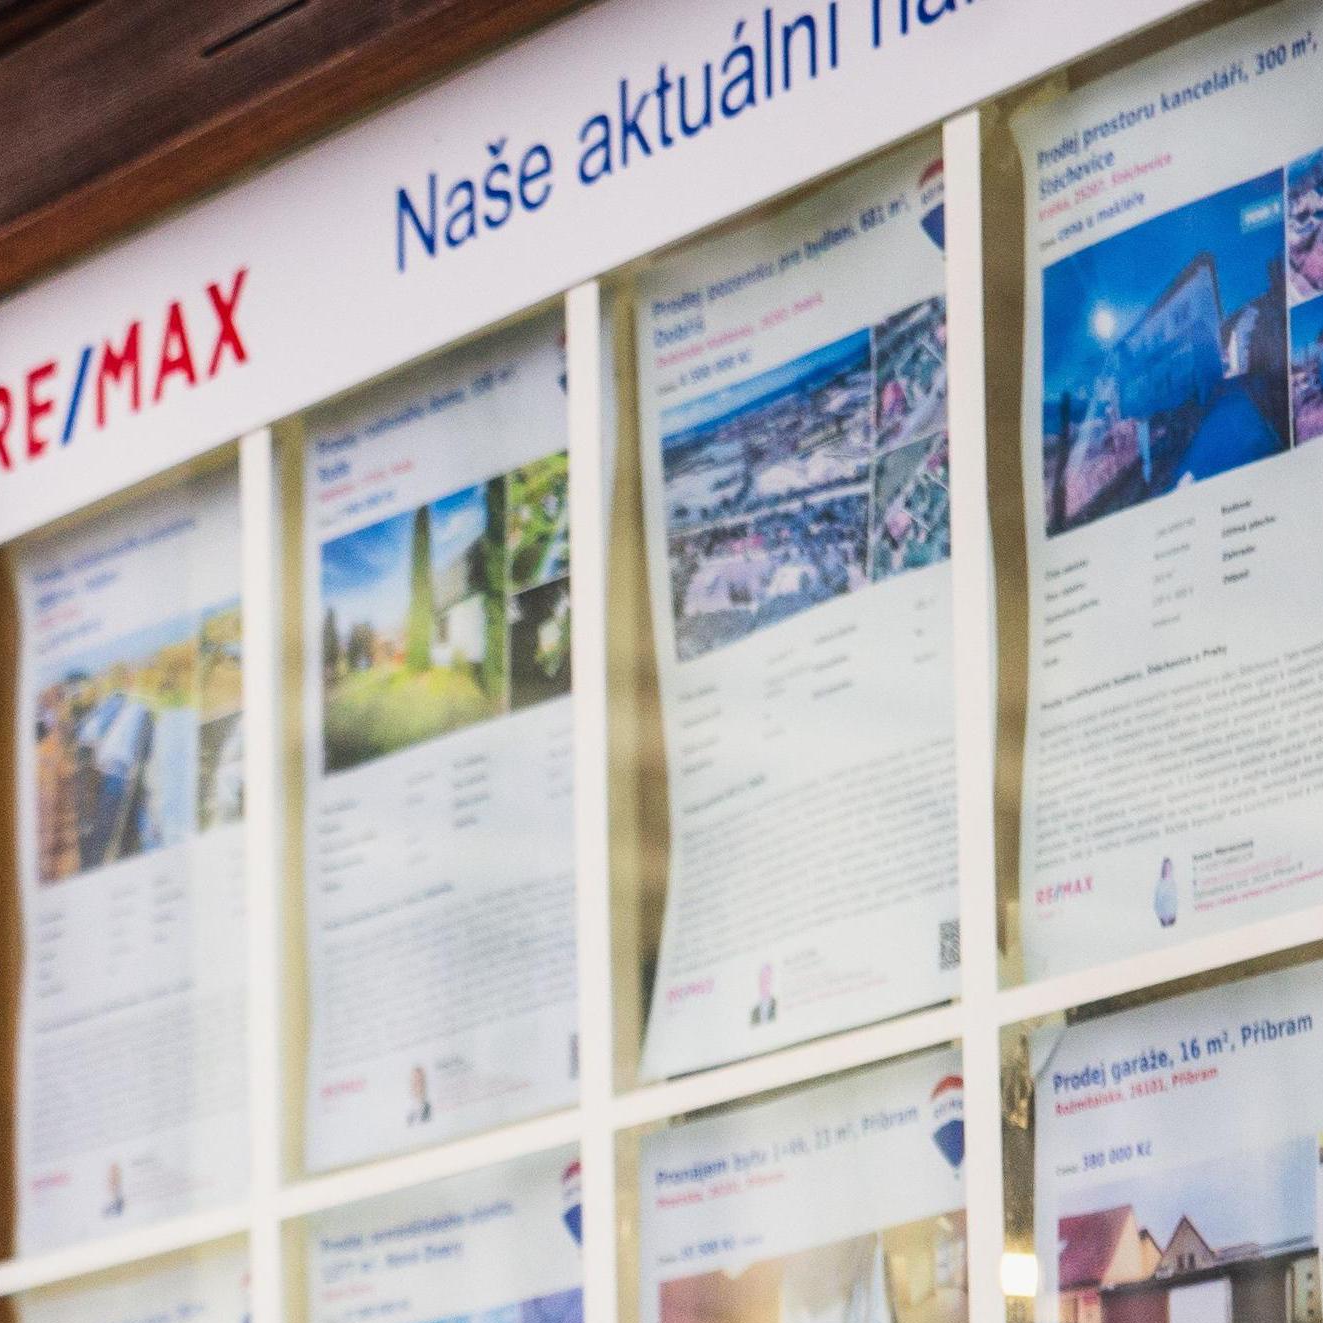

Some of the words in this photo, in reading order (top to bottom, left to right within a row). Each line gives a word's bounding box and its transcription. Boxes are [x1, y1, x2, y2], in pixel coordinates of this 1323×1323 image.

[396, 137, 553, 273] Naše
[576, 0, 839, 187] aktuální
[1082, 102, 1155, 148] prostoru
[1256, 45, 1286, 75] 300
[1054, 1063, 1106, 1093] Prodej
[1111, 1048, 1174, 1087] garáže,
[1179, 1037, 1201, 1062] 16
[1241, 1014, 1313, 1047] Příbram
